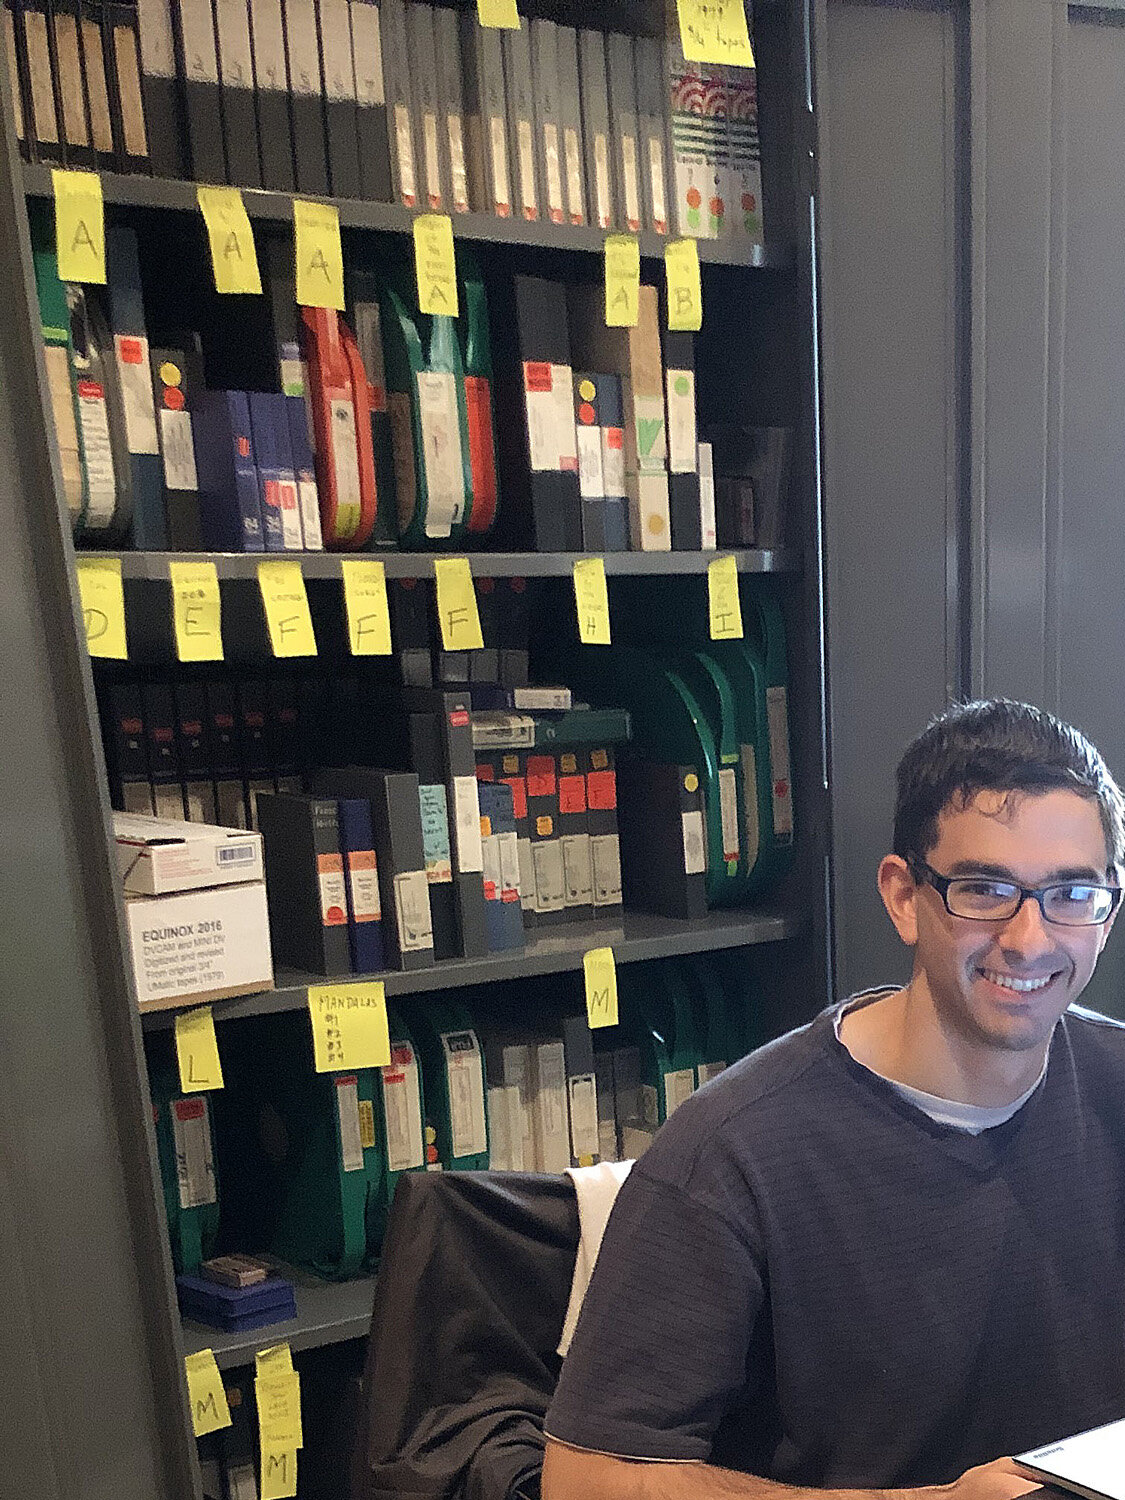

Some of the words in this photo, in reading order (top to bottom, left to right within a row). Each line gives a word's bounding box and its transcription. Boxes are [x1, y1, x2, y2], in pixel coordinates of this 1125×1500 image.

[71, 220, 98, 257] A
[223, 231, 243, 261] A
[306, 249, 332, 284] A
[428, 285, 448, 308] A
[611, 286, 630, 310] A
[675, 286, 693, 315] B
[185, 606, 212, 636] E
[278, 615, 300, 643] F
[356, 614, 378, 650] F
[446, 607, 469, 636] F
[586, 616, 596, 636] H
[142, 924, 194, 943] EQUINOX
[197, 920, 222, 934] 2016
[319, 994, 378, 1012] MANDALAS
[590, 988, 610, 1016] M
[189, 1054, 210, 1083] L
[196, 1392, 221, 1424] M
[267, 1453, 288, 1484] M
